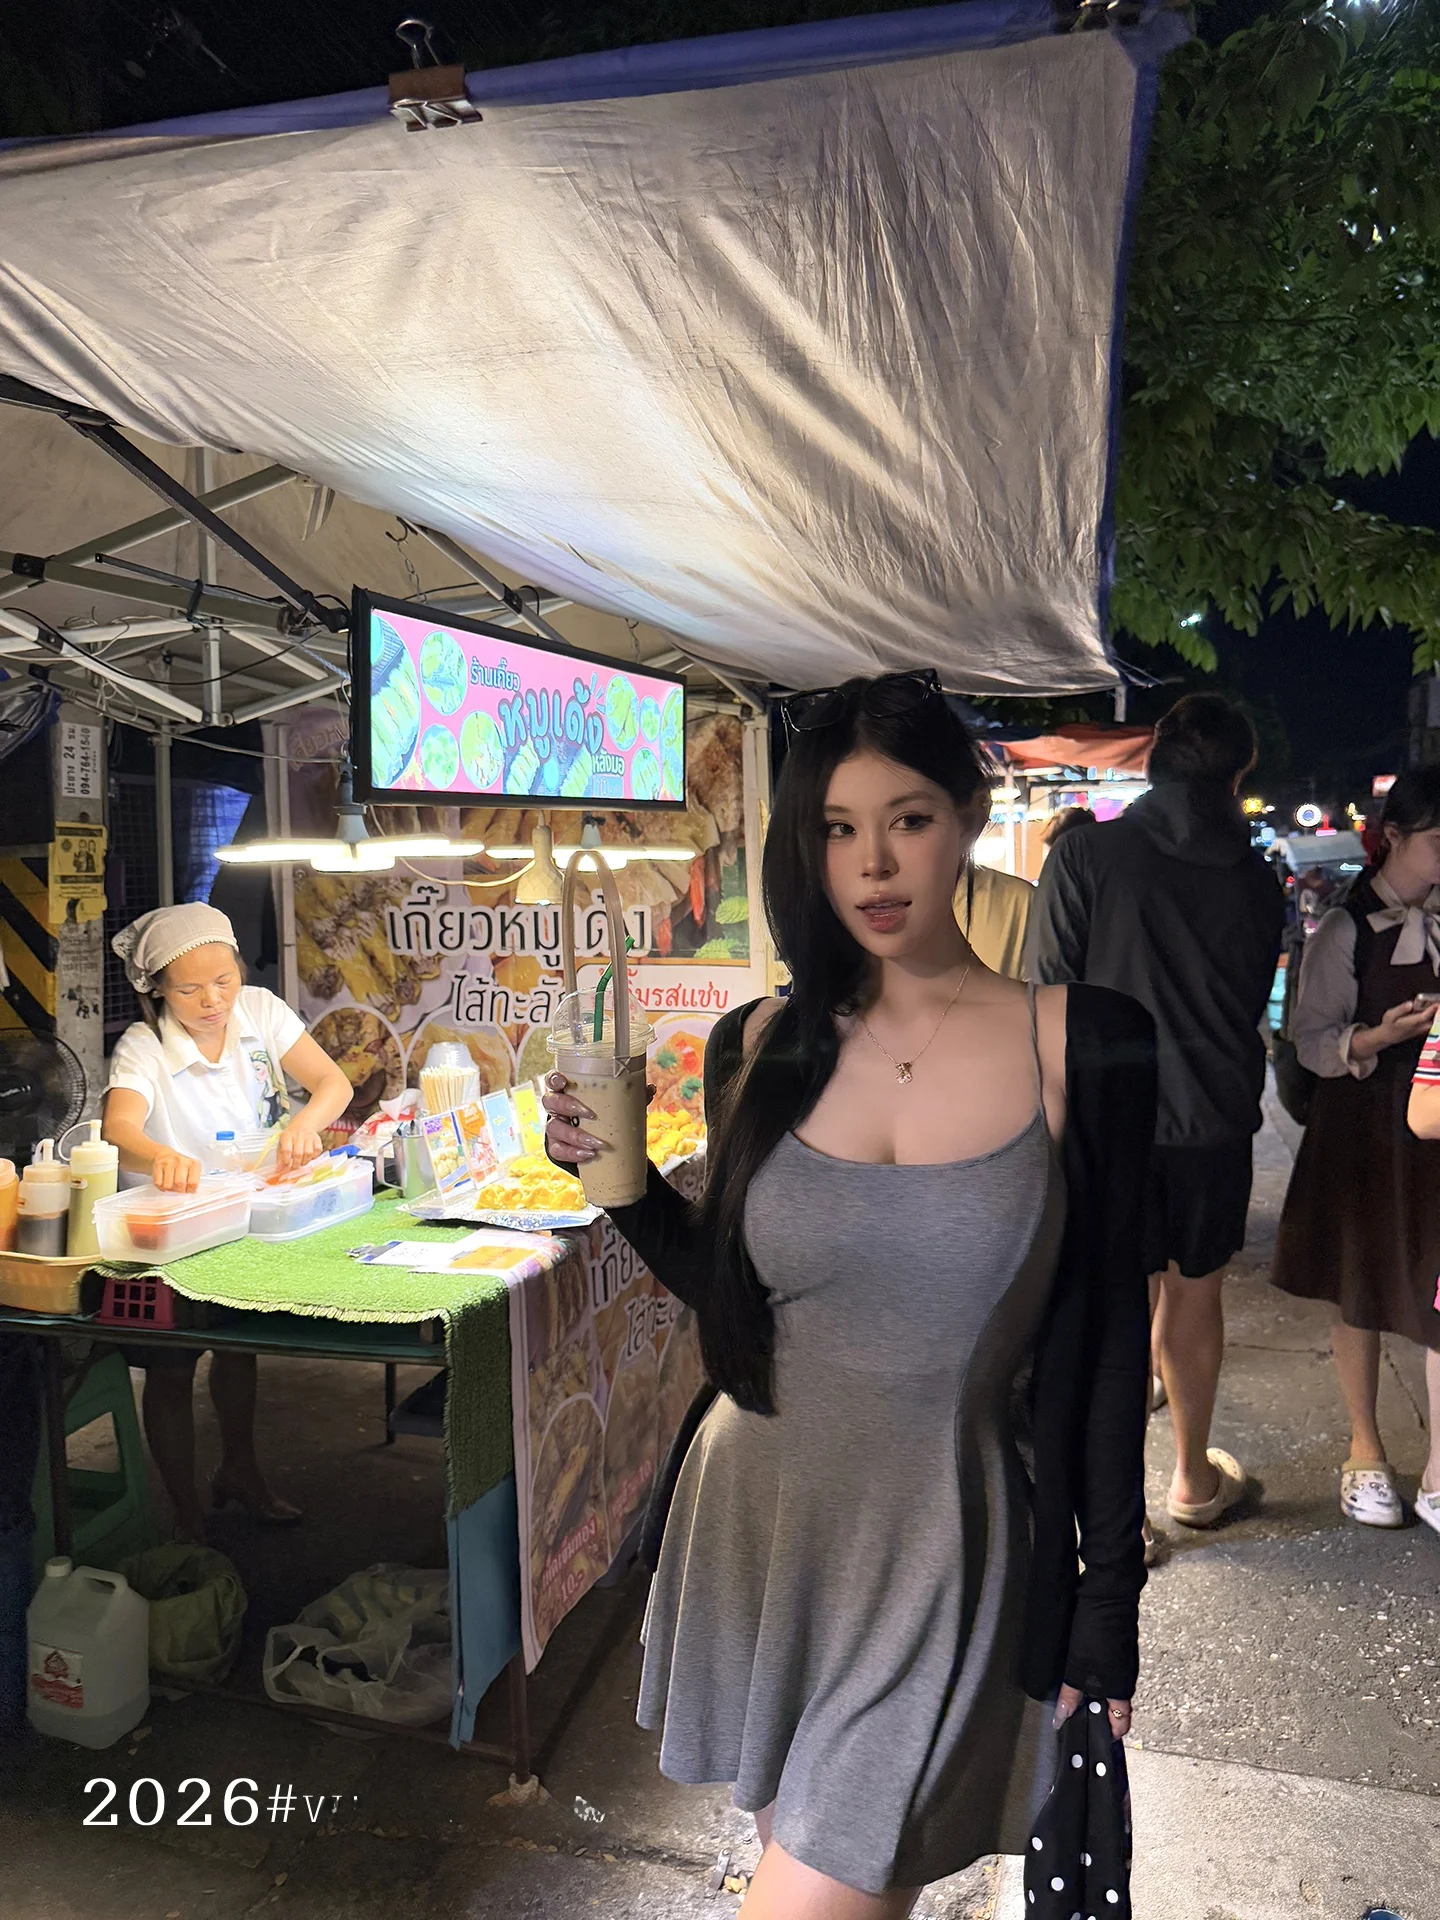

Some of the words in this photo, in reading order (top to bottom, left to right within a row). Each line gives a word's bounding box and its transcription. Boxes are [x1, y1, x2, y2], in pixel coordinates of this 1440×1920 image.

[498, 677, 604, 763] หมูเด้ง
[63, 745, 76, 760] 24
[454, 974, 567, 1022] ไส้ทะลั
